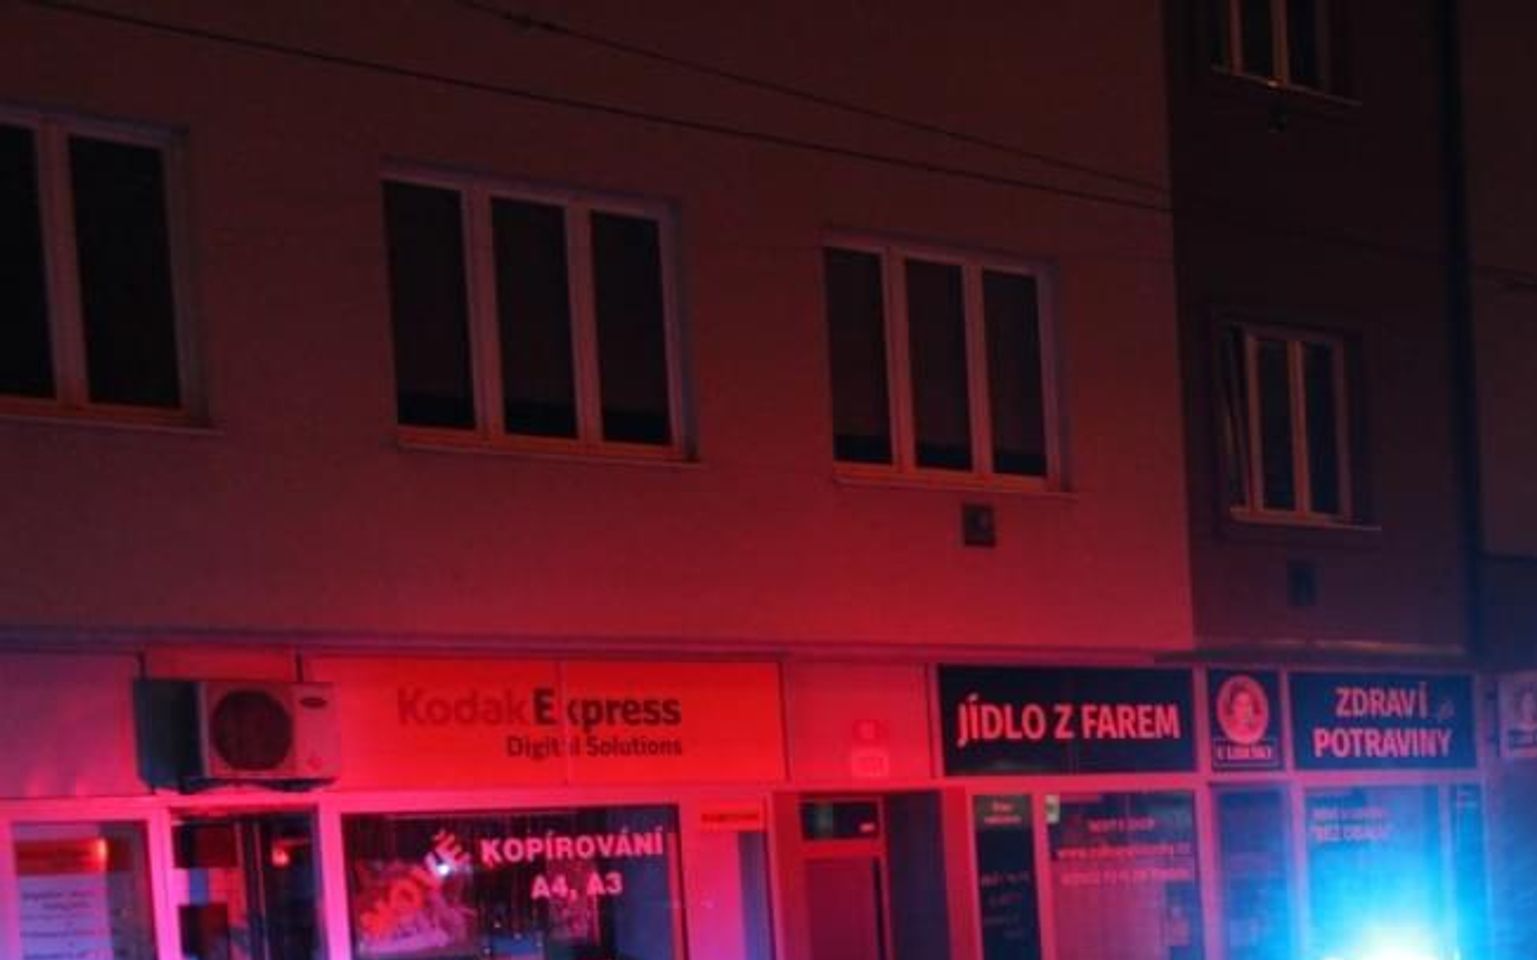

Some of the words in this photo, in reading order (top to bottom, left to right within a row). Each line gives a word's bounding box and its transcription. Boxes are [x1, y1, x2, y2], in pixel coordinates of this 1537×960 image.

[1333, 680, 1429, 719] ZDRAVÍ
[955, 690, 1047, 749] JÍDLO
[1050, 701, 1075, 740] Z
[1080, 701, 1182, 741] FAREM
[585, 735, 683, 758] Solutions
[1311, 725, 1453, 760] POTRAVINY
[479, 826, 664, 866] KOPÍROVÁNÍ
[584, 870, 625, 897] A3
